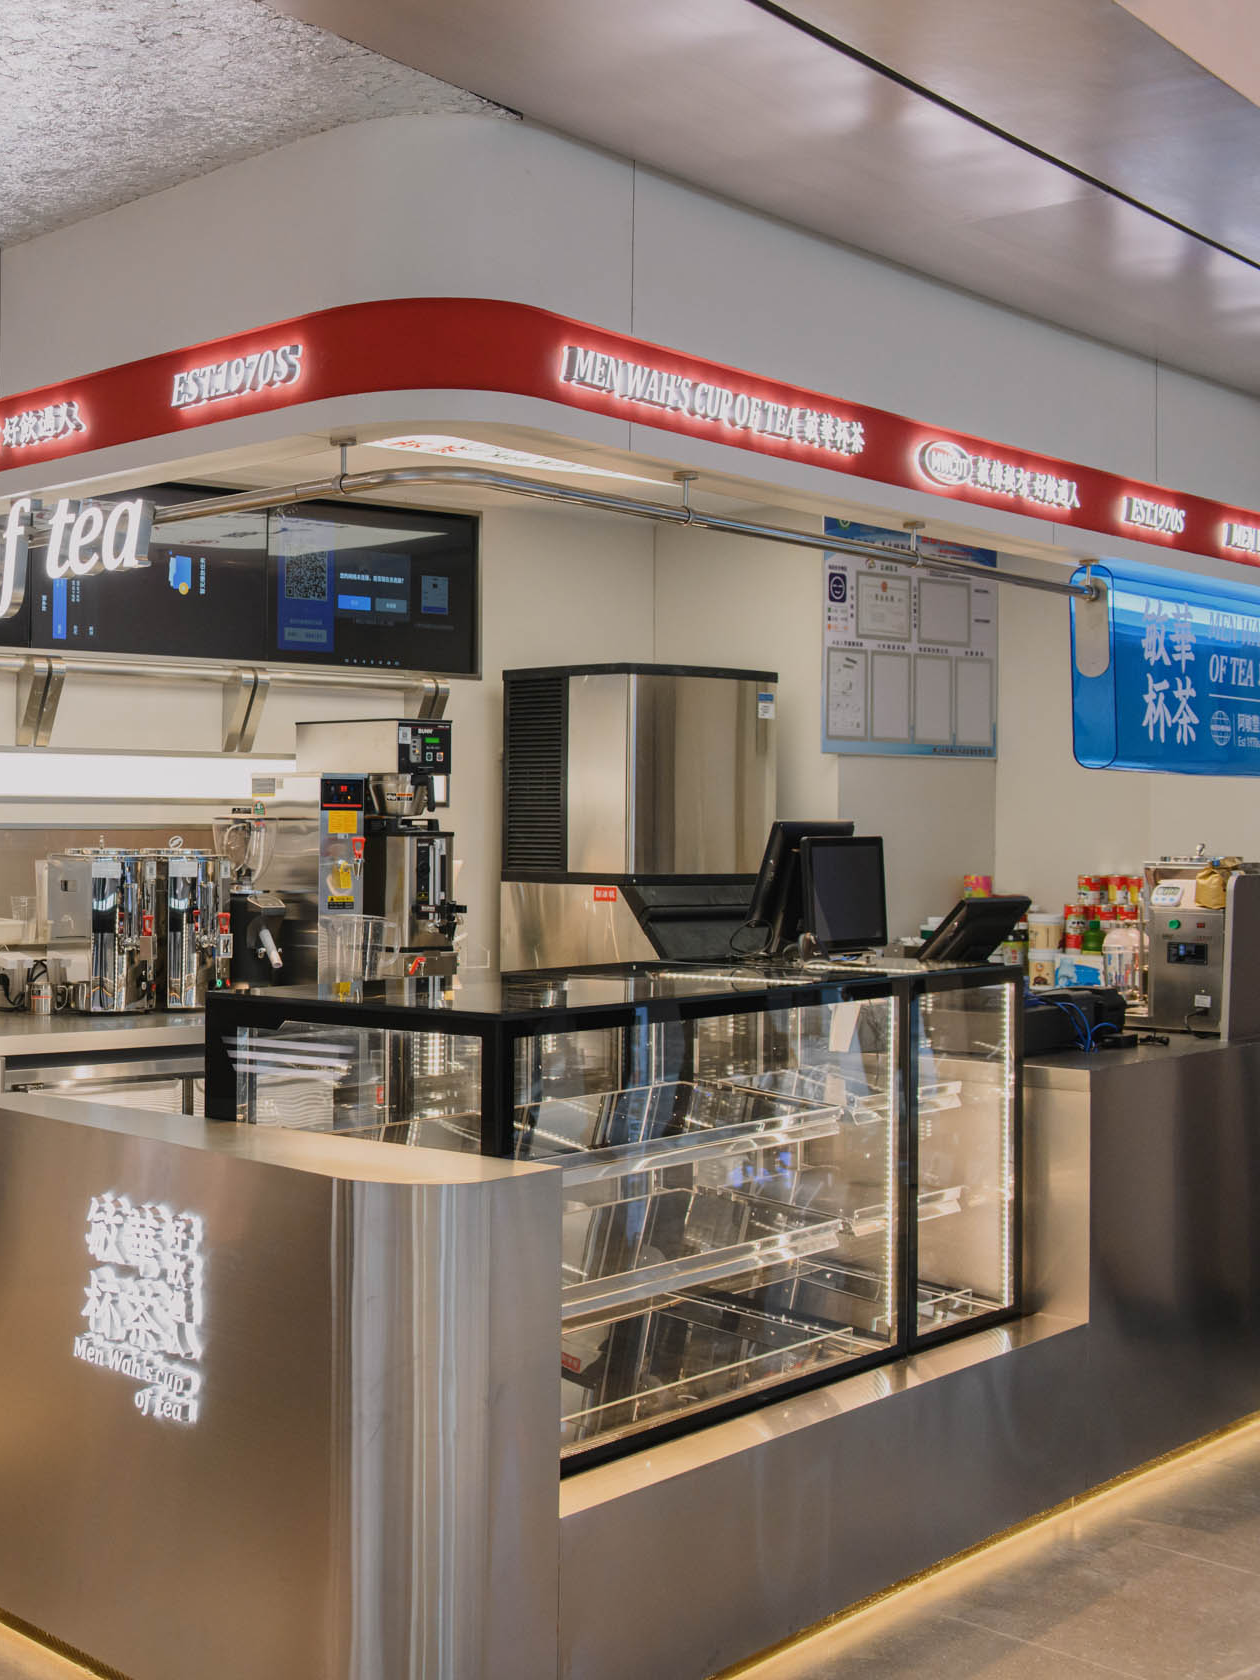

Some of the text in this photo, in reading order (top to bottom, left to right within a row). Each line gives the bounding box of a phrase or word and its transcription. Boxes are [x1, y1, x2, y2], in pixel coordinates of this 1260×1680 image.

[576, 347, 622, 393] MEN
[626, 362, 692, 410] WAH'S
[694, 382, 733, 422] CUP
[736, 394, 760, 429] OF
[765, 402, 799, 438] TEA
[45, 497, 145, 580] tea
[1141, 598, 1197, 675] 敏華
[1209, 654, 1255, 687] OF TEA
[1142, 673, 1200, 745] 杯茶
[81, 1269, 168, 1350] 杯茶
[73, 1335, 188, 1395] Men Wah's cup
[134, 1390, 183, 1421] of tea
